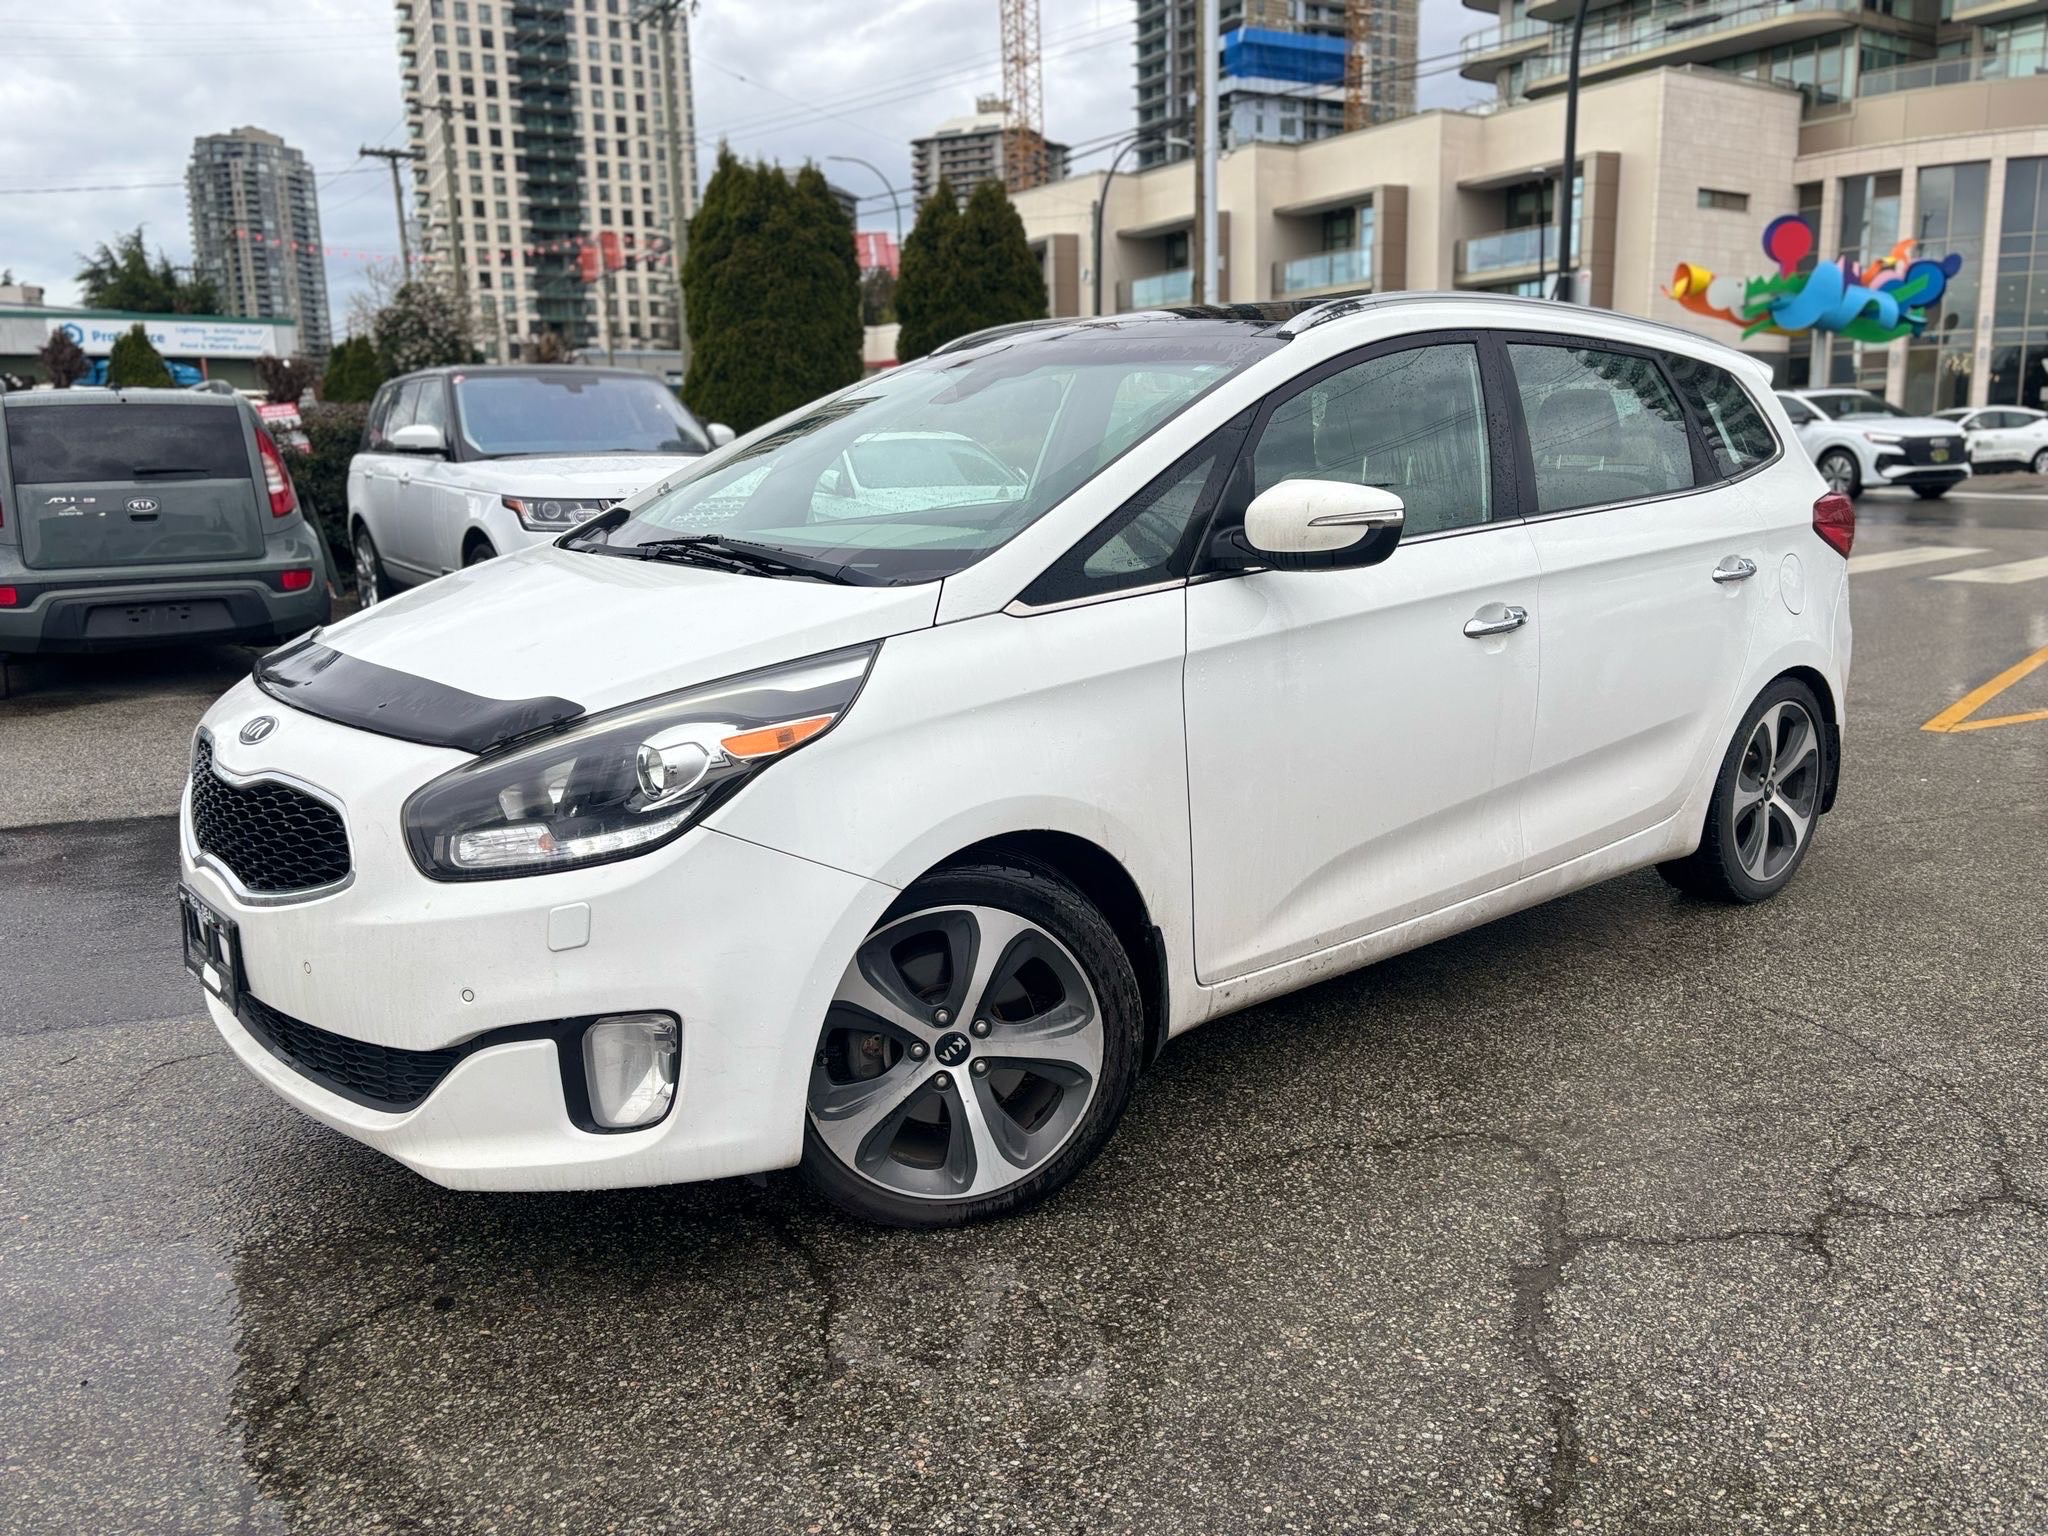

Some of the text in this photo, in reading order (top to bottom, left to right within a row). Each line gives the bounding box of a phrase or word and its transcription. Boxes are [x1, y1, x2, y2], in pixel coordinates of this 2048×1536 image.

[131, 500, 155, 510] KIA
[242, 718, 272, 740] KIA
[938, 1036, 967, 1062] KIA
